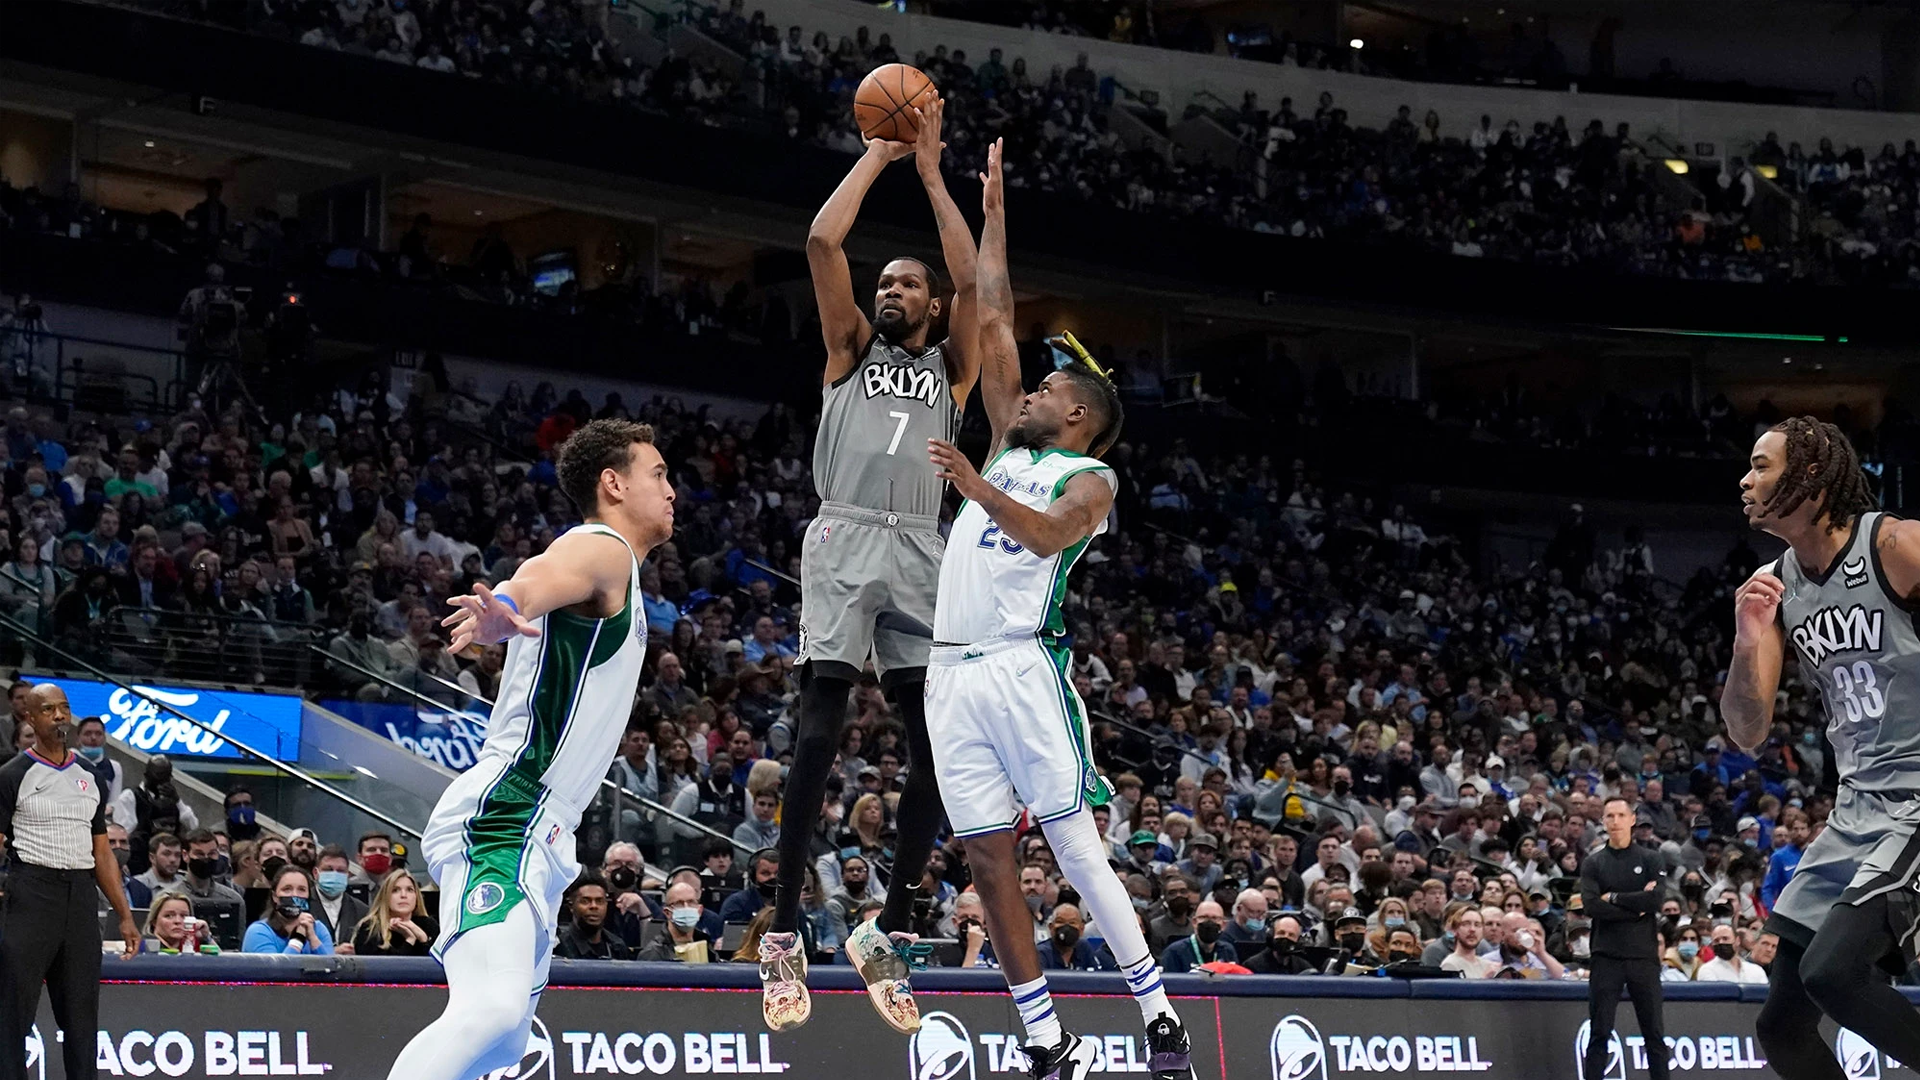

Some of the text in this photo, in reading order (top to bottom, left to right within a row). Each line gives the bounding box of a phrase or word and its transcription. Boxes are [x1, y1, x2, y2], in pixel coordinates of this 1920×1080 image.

[863, 362, 942, 408] BKLYN
[886, 410, 910, 455] 7
[1792, 604, 1883, 667] BKLYN
[1833, 661, 1885, 723] 33
[101, 685, 230, 754] Ford
[56, 1031, 325, 1076] ACO BELL
[562, 1033, 785, 1074] TACO BELL
[1085, 1035, 1151, 1072] BEL
[1329, 1036, 1488, 1072] TACO BELL
[1699, 1036, 1764, 1069] BELL
